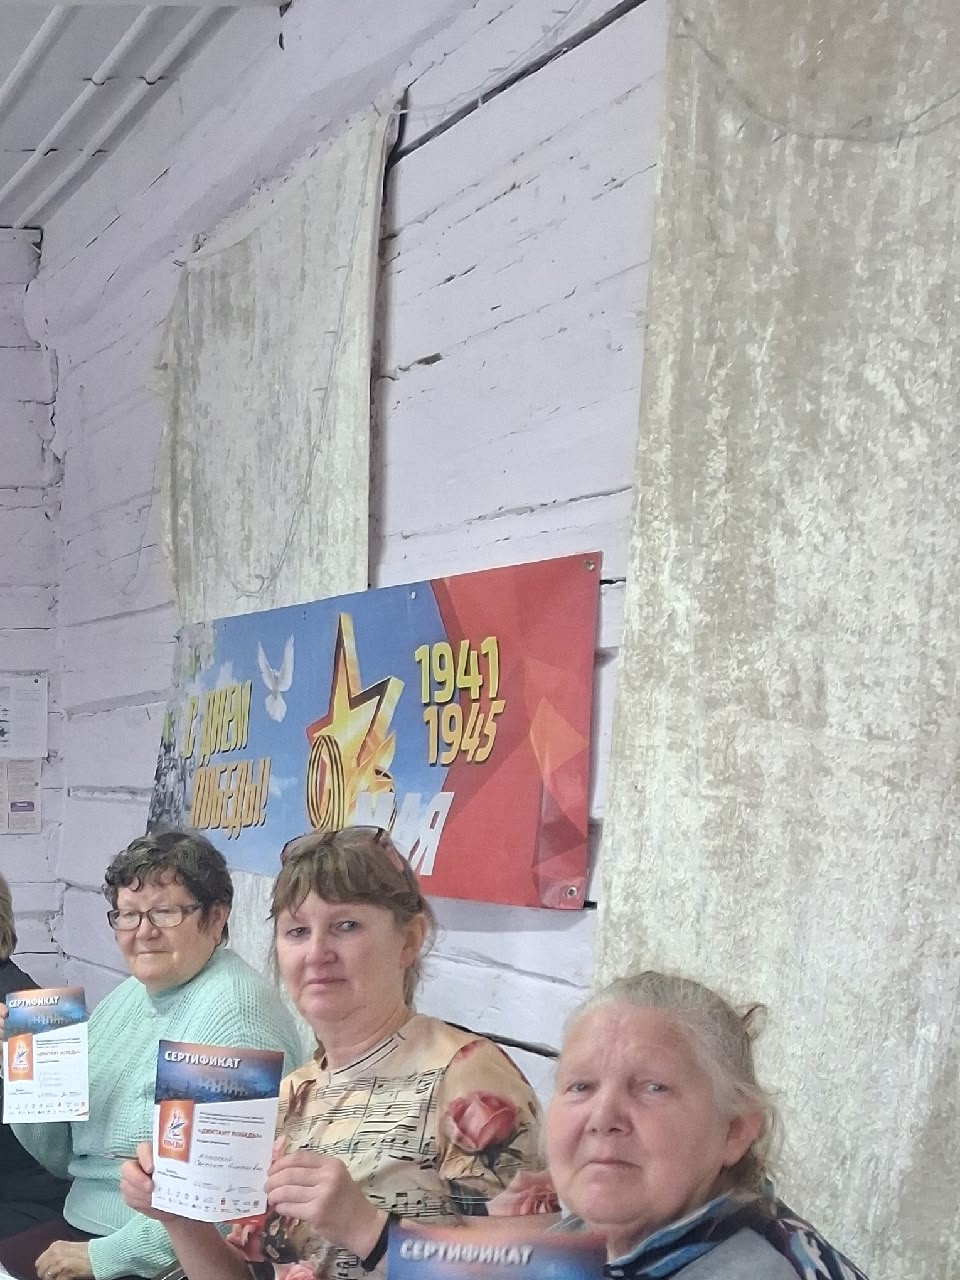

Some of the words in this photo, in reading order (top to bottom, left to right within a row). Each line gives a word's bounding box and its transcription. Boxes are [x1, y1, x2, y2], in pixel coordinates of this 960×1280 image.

[414, 636, 500, 704] 1941
[183, 695, 198, 759] С
[199, 680, 252, 767] ДНЕМ
[423, 700, 506, 766] 1945
[190, 756, 271, 840] ПОБЕДЫ!
[8, 996, 60, 1009] СЕРТИФИКАТ
[164, 1050, 241, 1069] СЕРТИФИКАТ
[400, 1239, 533, 1265] СЕРТИФИКАТ
